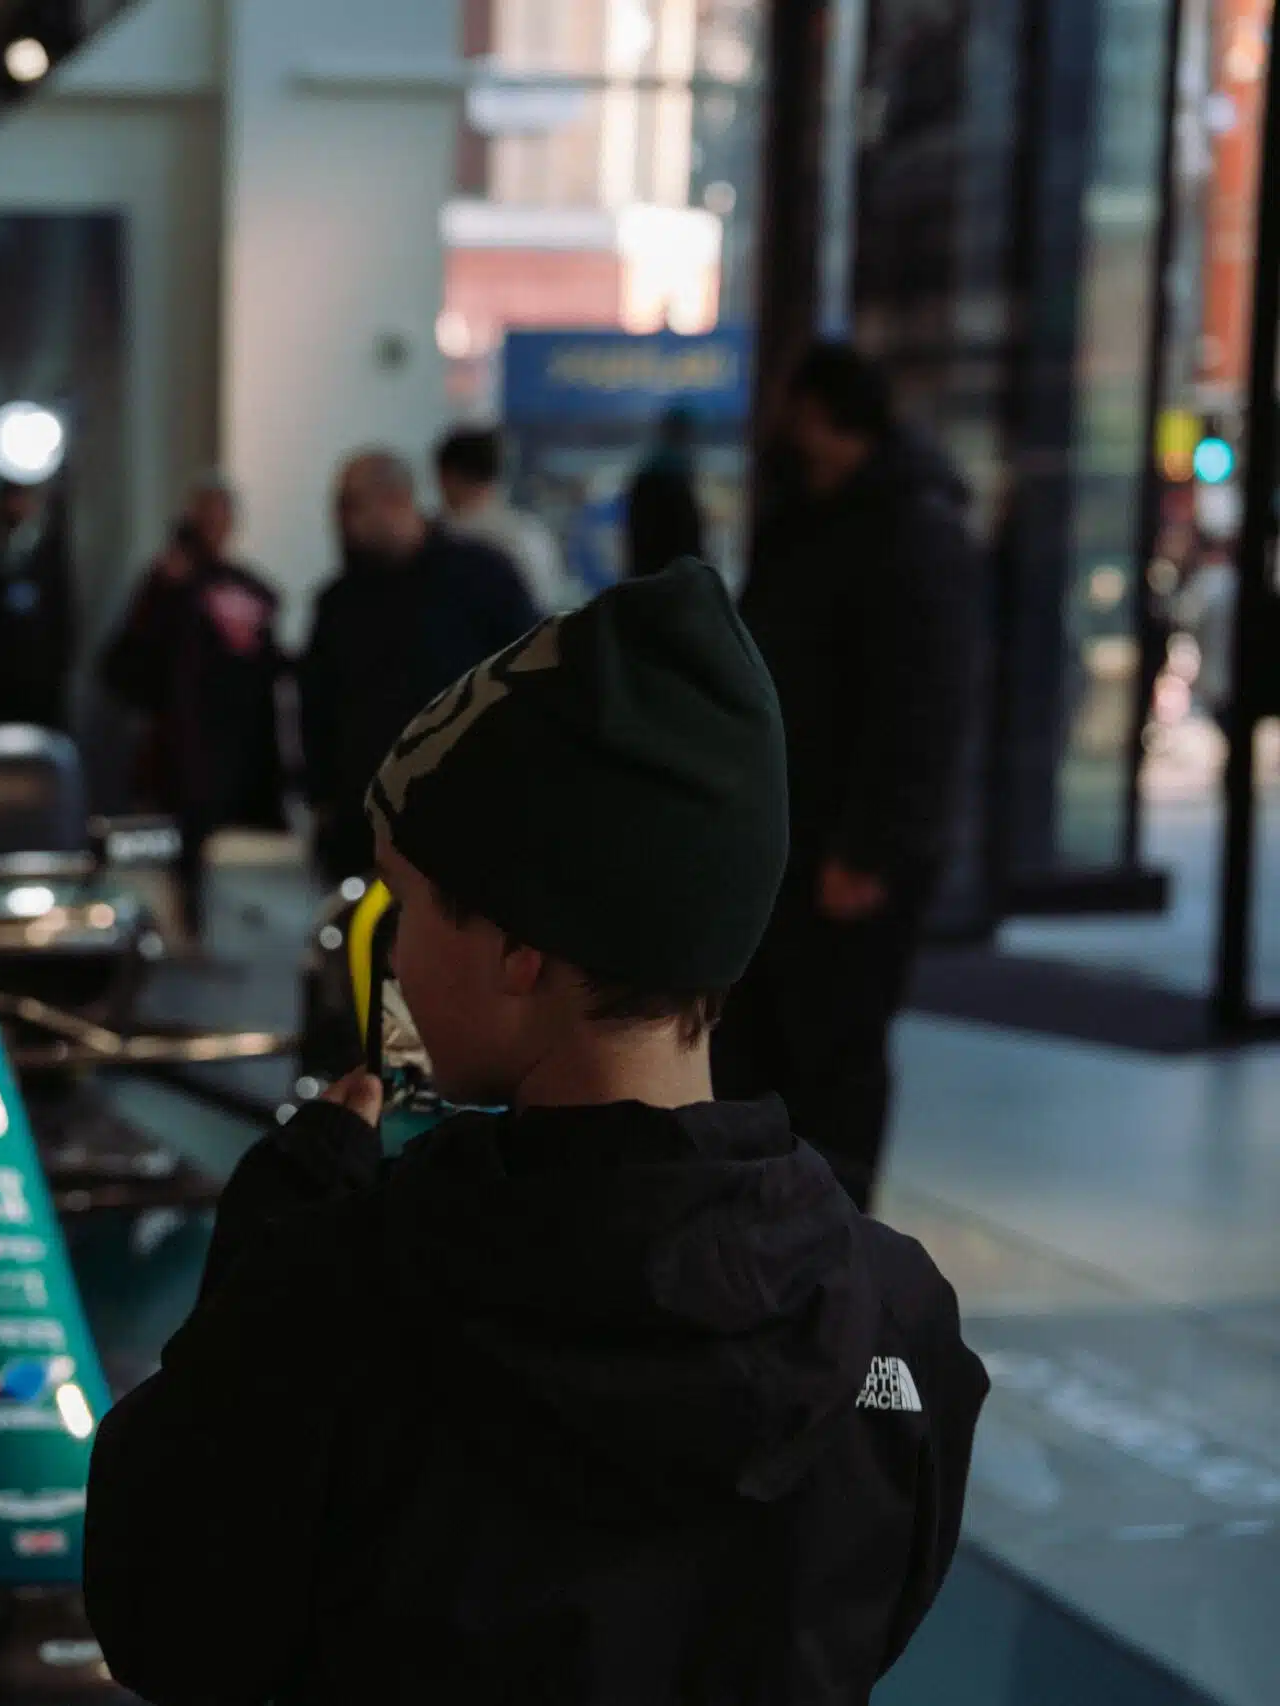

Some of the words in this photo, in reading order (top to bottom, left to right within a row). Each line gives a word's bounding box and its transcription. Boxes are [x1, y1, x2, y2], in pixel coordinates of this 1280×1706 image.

[871, 1356, 898, 1374] THE
[865, 1372, 900, 1393] RTH
[855, 1389, 902, 1410] FACE
